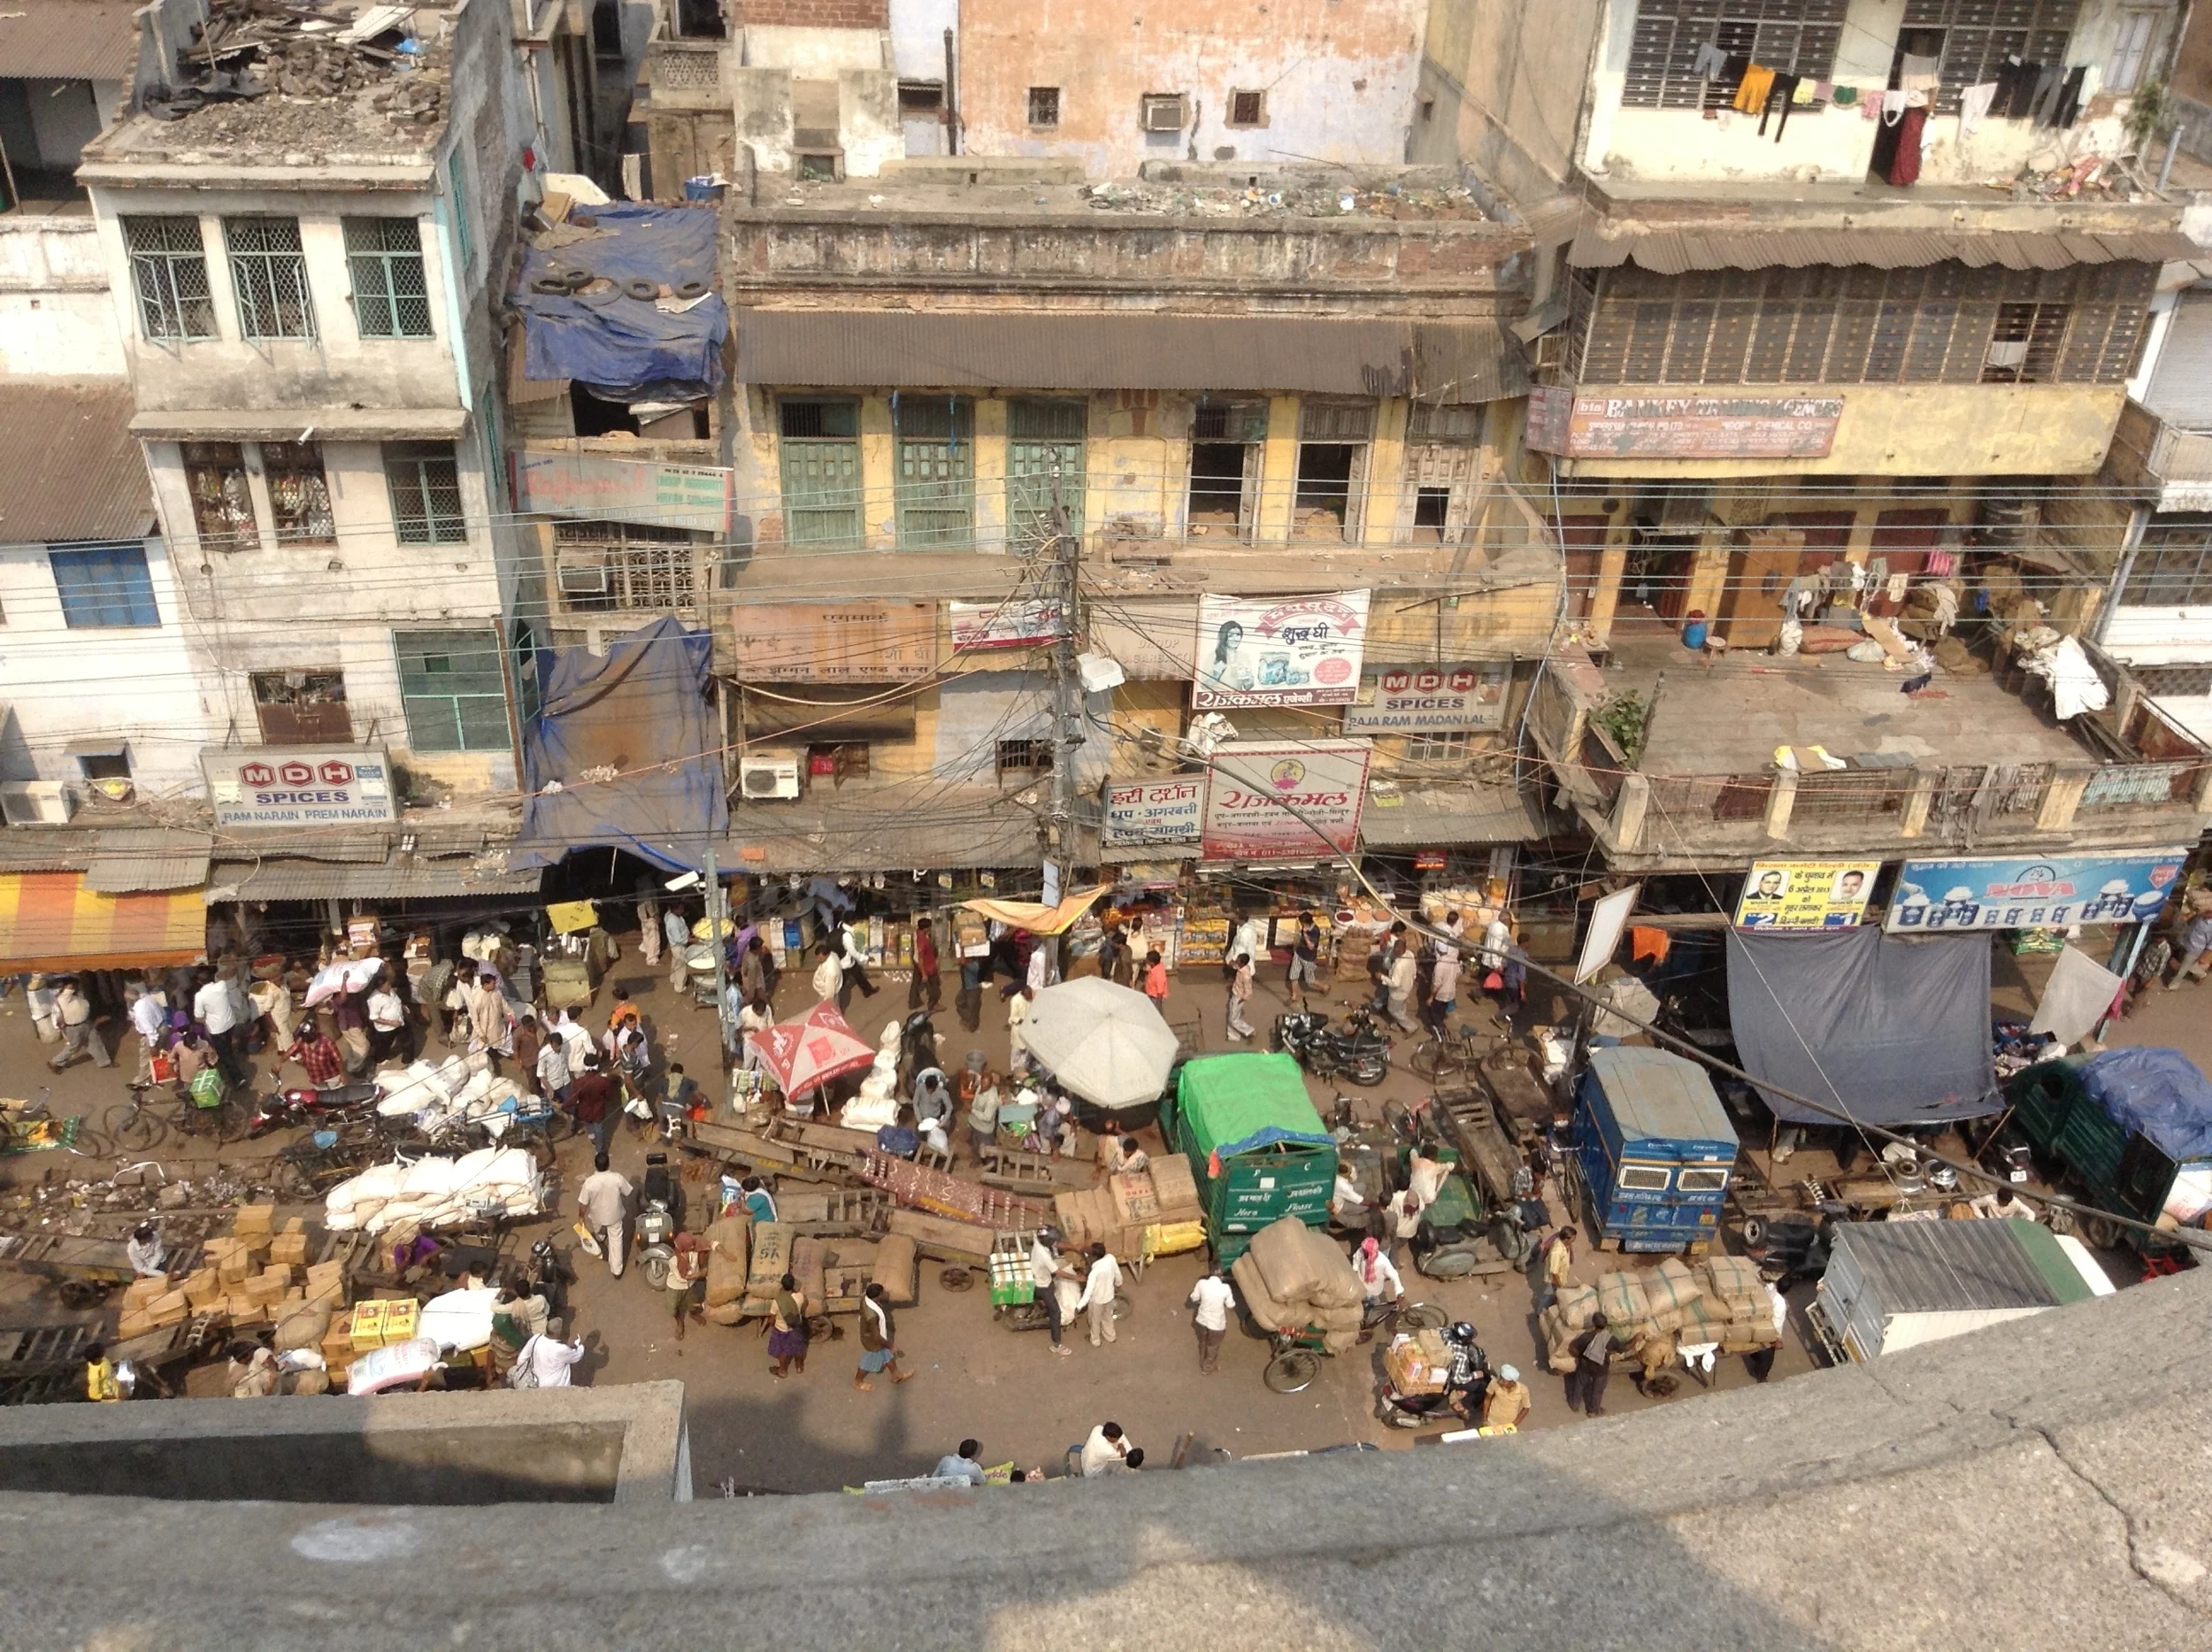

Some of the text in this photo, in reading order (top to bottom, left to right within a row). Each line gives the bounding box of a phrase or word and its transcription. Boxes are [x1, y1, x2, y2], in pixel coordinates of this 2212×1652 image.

[1382, 671, 1476, 691] MDH
[1386, 698, 1465, 711] SPICES
[1382, 715, 1411, 726] RAM
[1415, 714, 1462, 726] MADAN
[242, 763, 352, 786] MDH
[256, 790, 350, 804] SPICES
[223, 808, 388, 822] RAM NARAIN PREM NARAIN
[1984, 881, 2076, 899] NOVA
[1755, 913, 1776, 926] 2
[1840, 913, 1855, 926] 1
